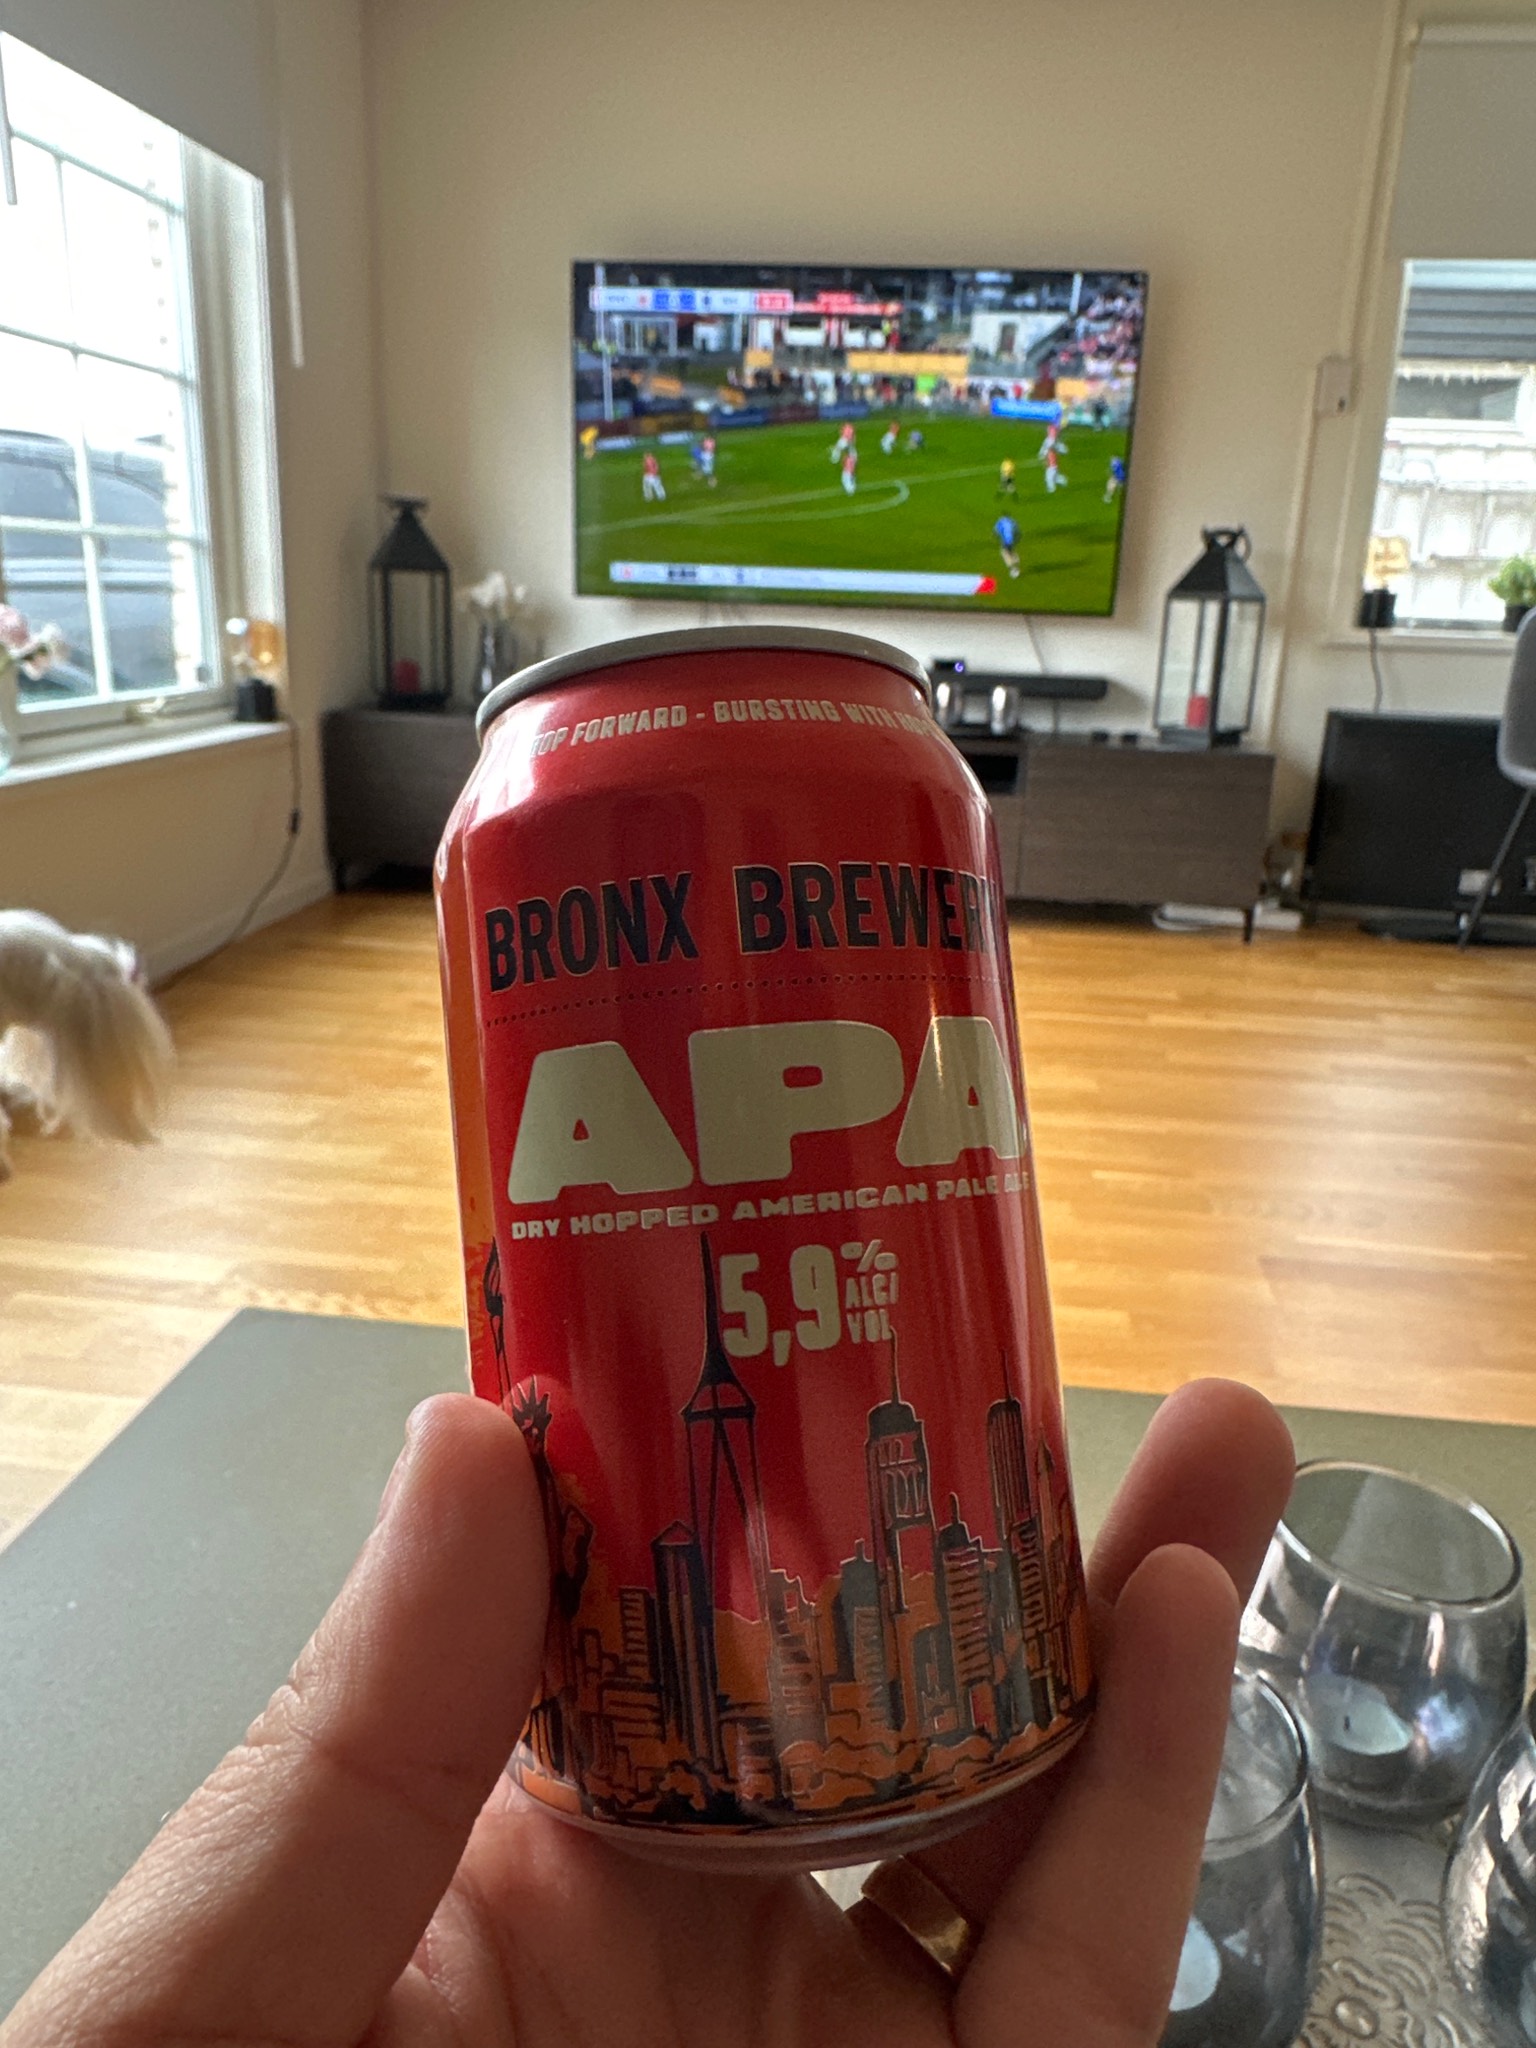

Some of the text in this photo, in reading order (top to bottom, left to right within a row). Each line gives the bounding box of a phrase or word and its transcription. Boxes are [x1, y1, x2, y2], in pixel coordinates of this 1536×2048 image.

[570, 704, 688, 747] FORWARD
[714, 700, 841, 723] BURSTING
[840, 701, 898, 729] WITH
[485, 870, 698, 994] BRONX
[507, 1016, 1027, 1204] APA
[511, 1217, 560, 1240] DRY
[570, 1203, 719, 1235] HOPPED
[732, 1182, 929, 1221] AMERICAN
[936, 1174, 999, 1201] PALE
[719, 1239, 897, 1366] 5,9 %
[847, 1308, 893, 1344] VOL
